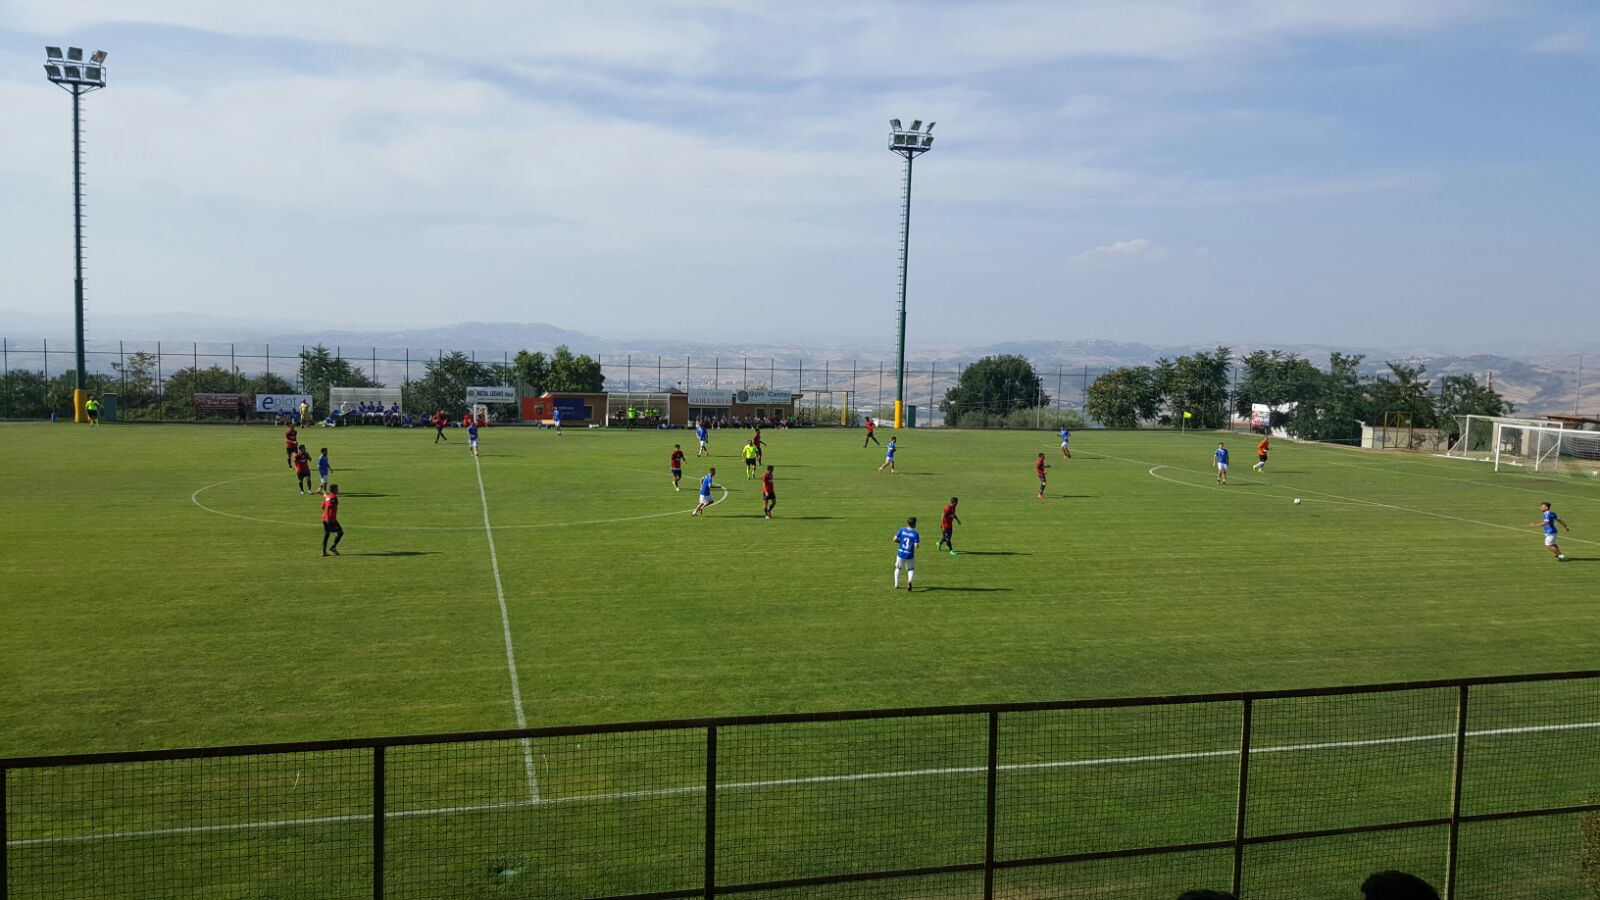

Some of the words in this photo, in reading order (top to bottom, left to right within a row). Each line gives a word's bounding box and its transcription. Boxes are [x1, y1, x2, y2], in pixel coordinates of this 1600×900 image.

[749, 390, 765, 398] Gym
[262, 396, 297, 410] eplot
[902, 537, 910, 550] 3
